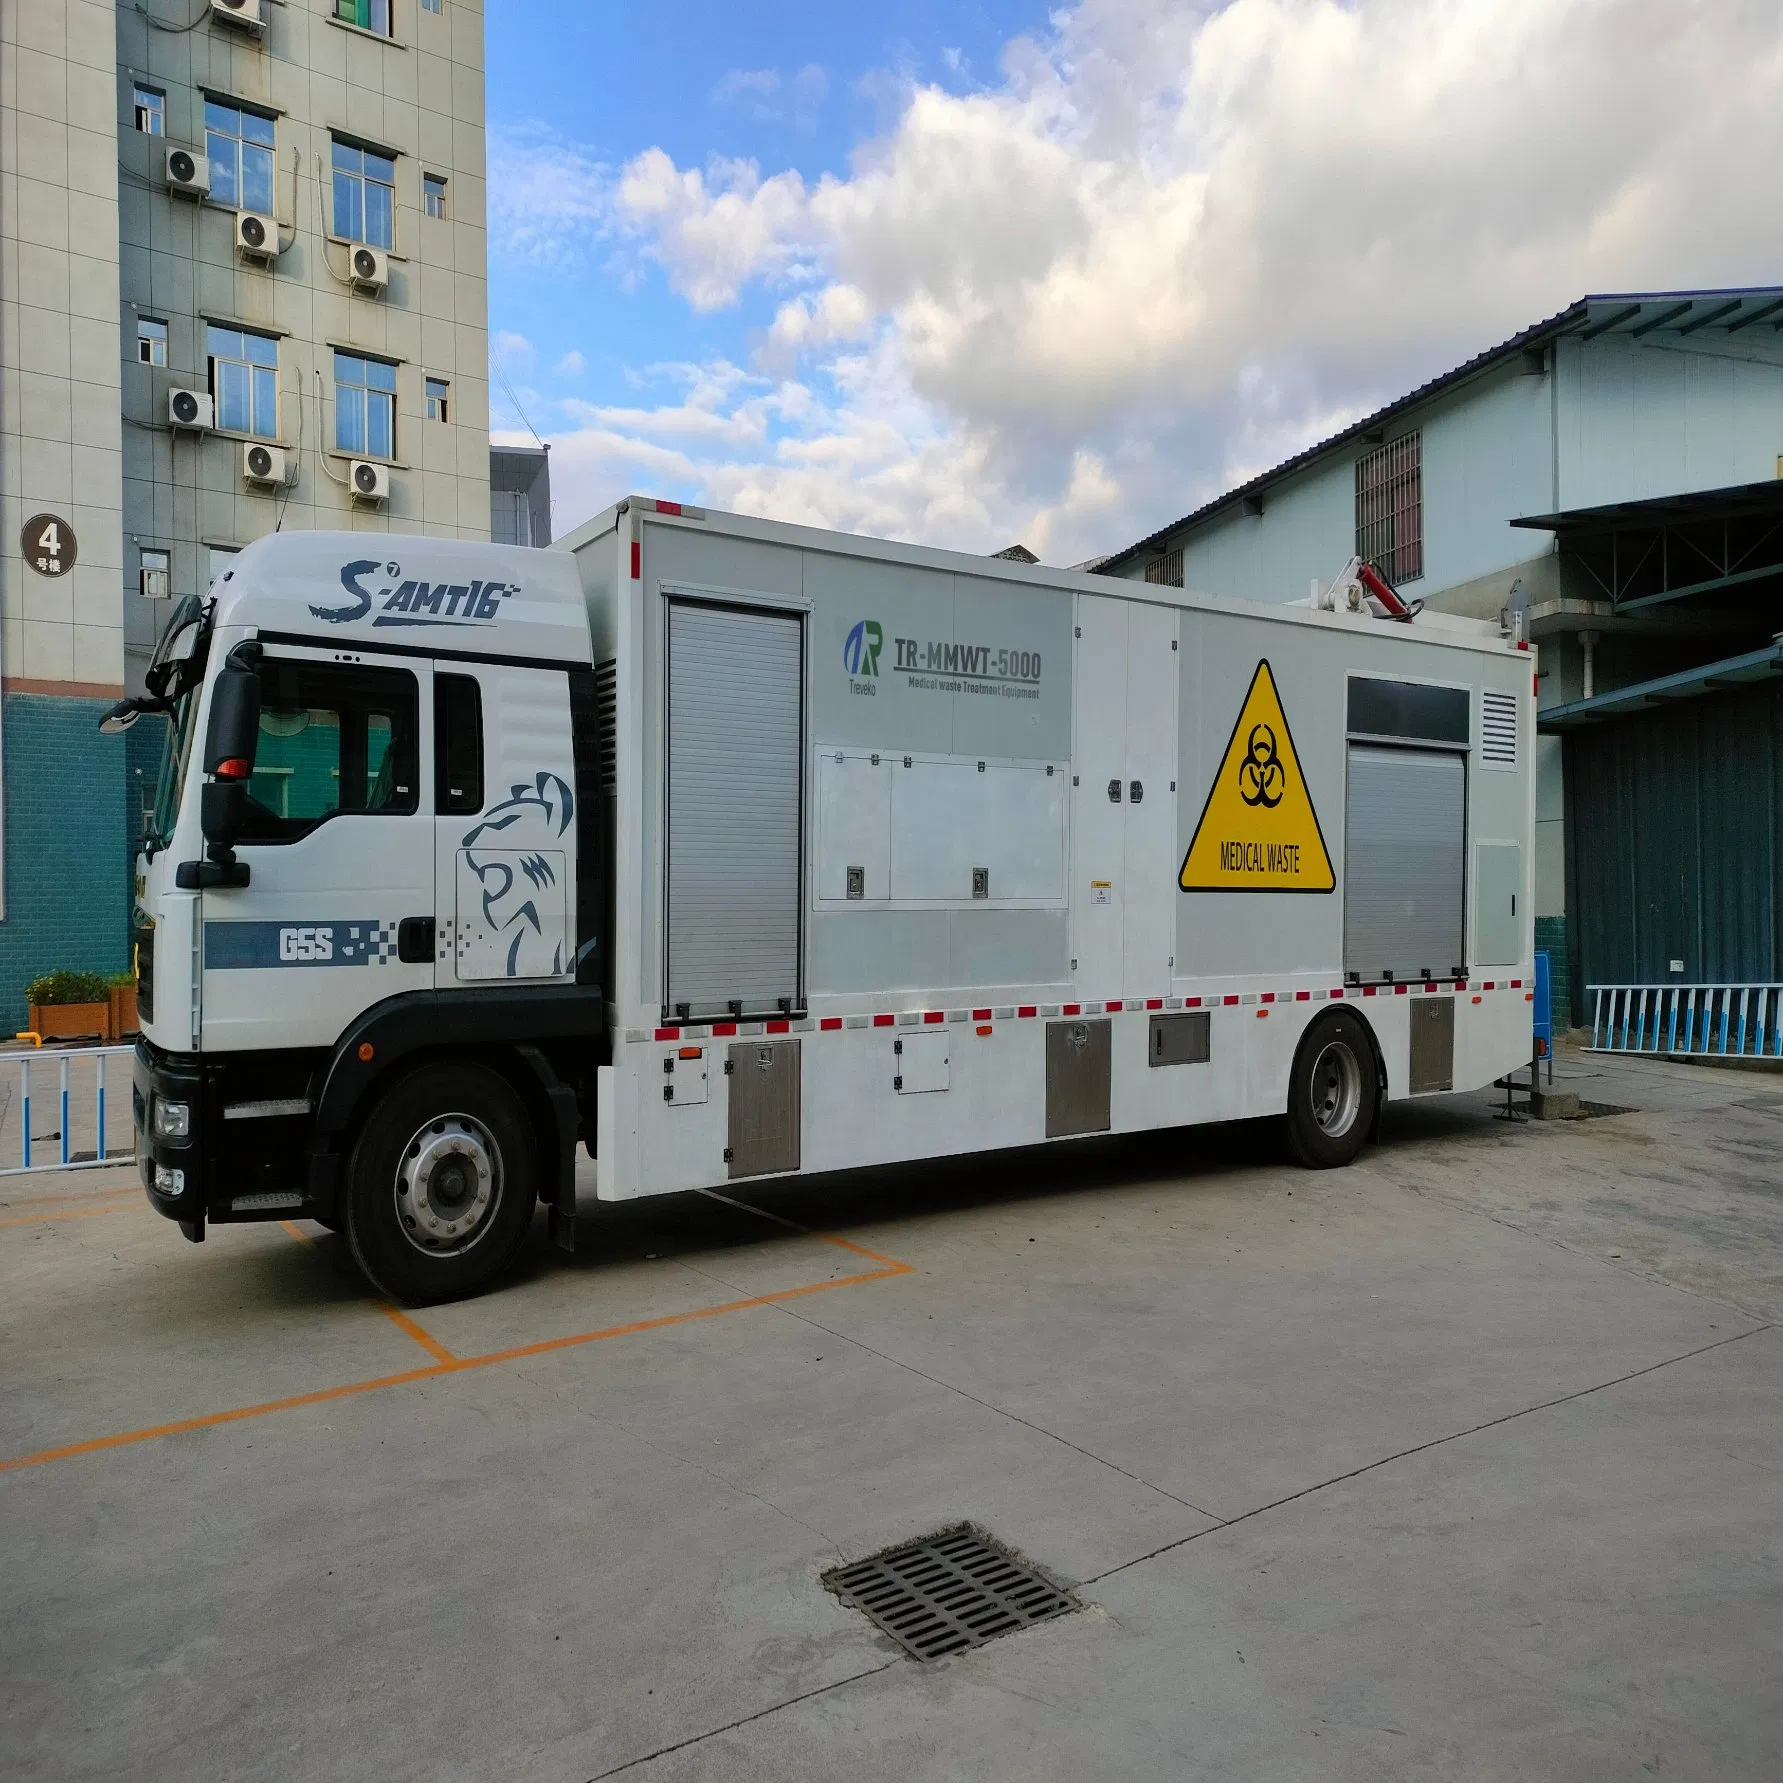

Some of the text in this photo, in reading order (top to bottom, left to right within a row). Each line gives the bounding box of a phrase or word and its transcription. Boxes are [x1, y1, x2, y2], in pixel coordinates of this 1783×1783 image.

[39, 522, 61, 555] 4
[36, 557, 61, 572] 号楼
[894, 638, 1041, 679] TR-MMWT-5000
[849, 679, 876, 696] Treveko
[908, 676, 1040, 699] Medical waste Treatment Equipment
[1220, 841, 1300, 873] MEDICAL WASTE
